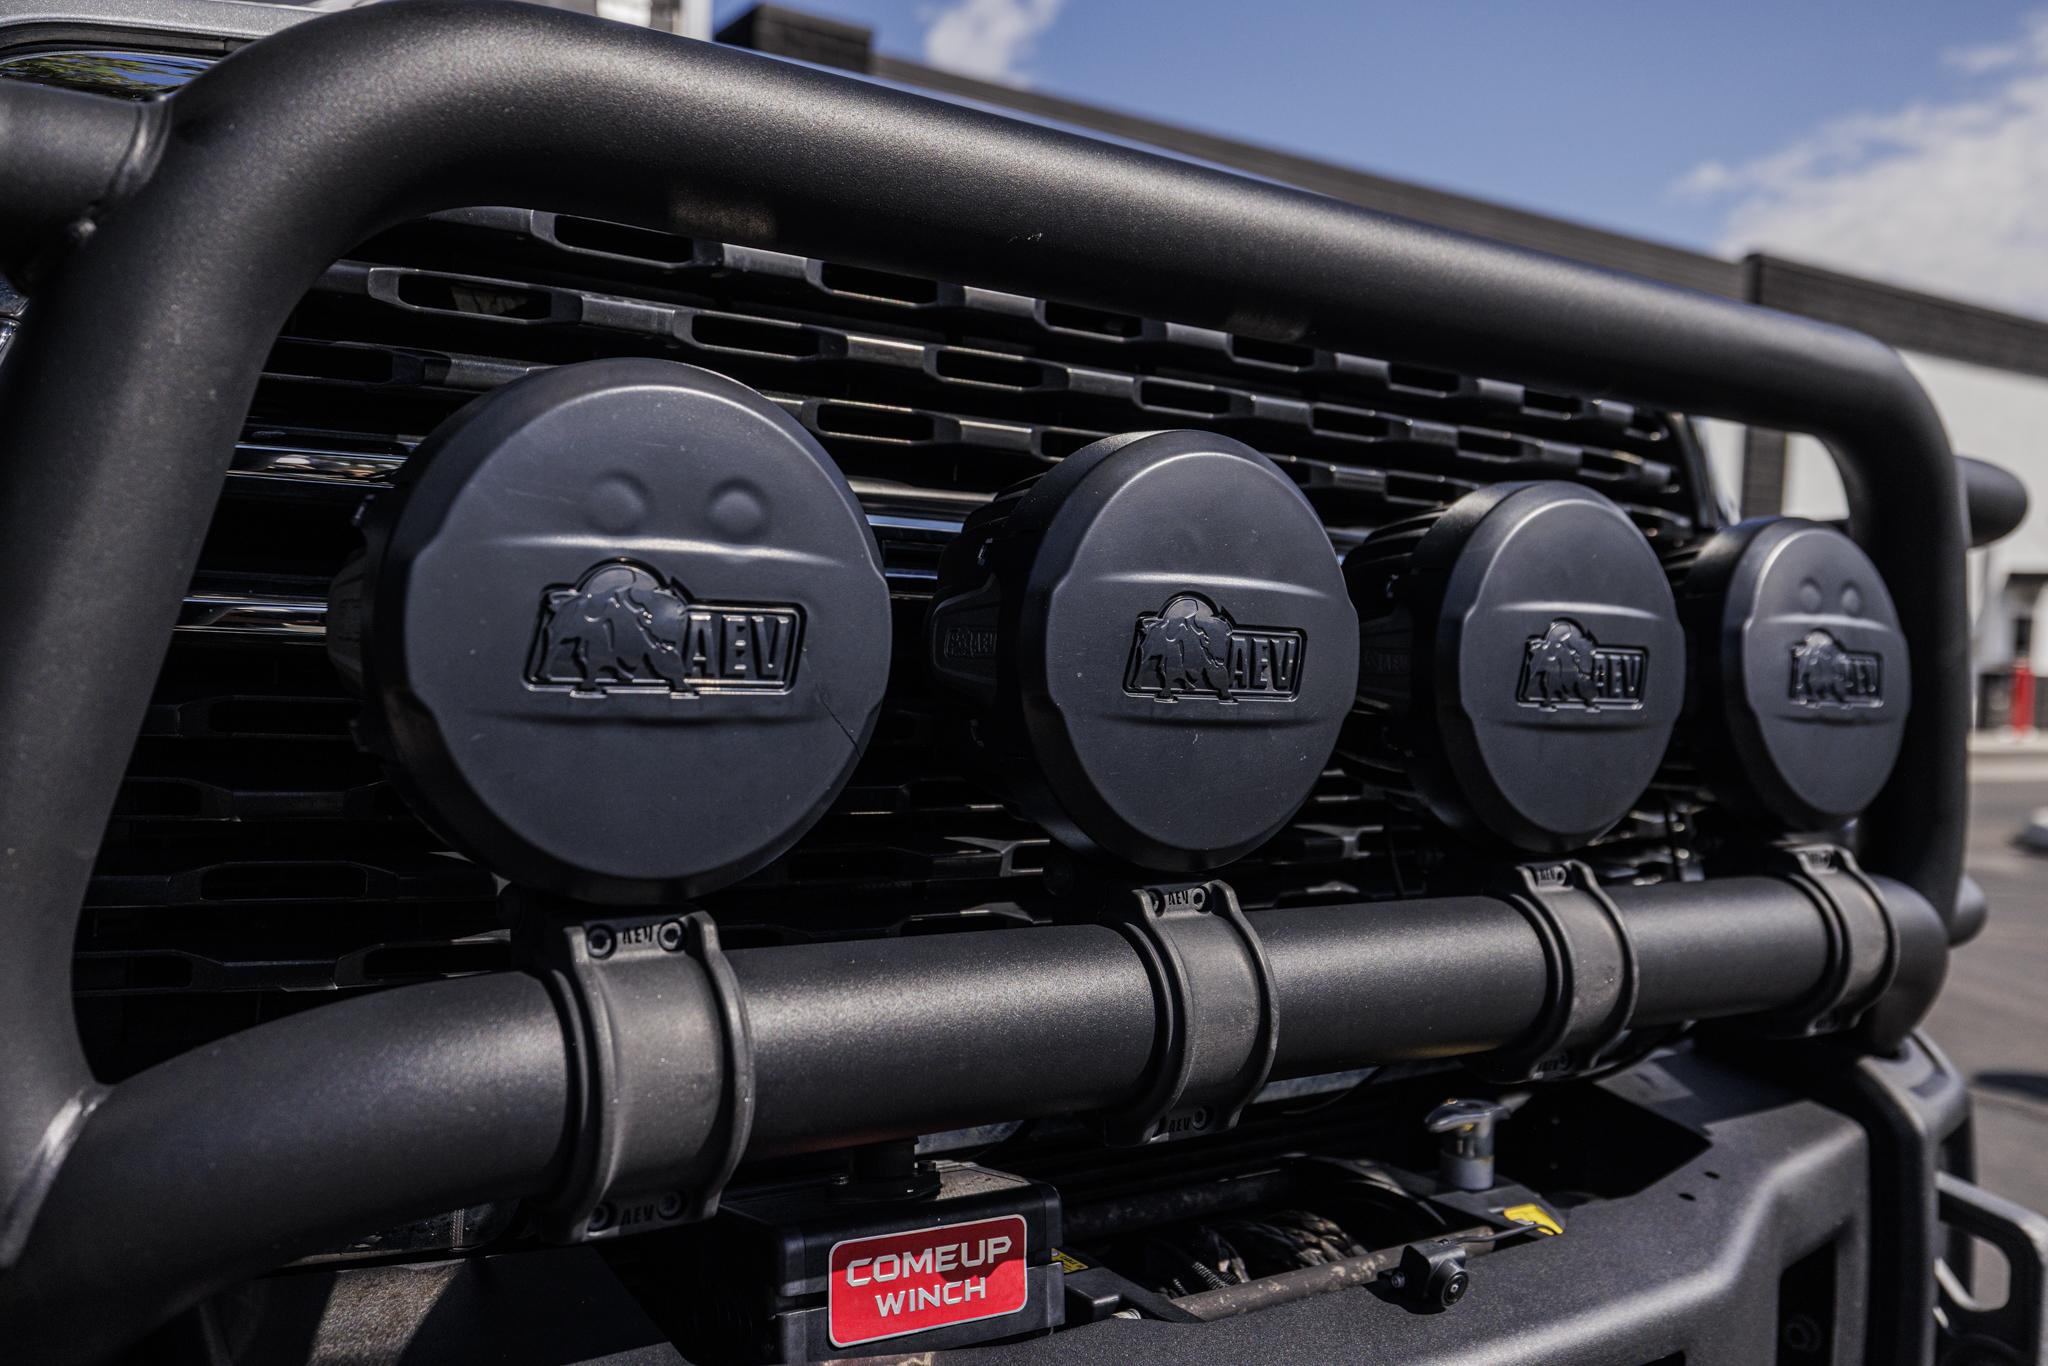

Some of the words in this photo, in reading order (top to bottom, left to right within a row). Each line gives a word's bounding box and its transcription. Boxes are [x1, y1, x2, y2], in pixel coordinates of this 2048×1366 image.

[685, 613, 791, 679] AEV
[1227, 636, 1298, 690] AEV
[1592, 653, 1643, 699] AEV
[1167, 890, 1190, 906] AEV
[621, 924, 654, 945] AEV
[846, 1235, 1013, 1287] COMEUP
[874, 1276, 987, 1318] WINCH
